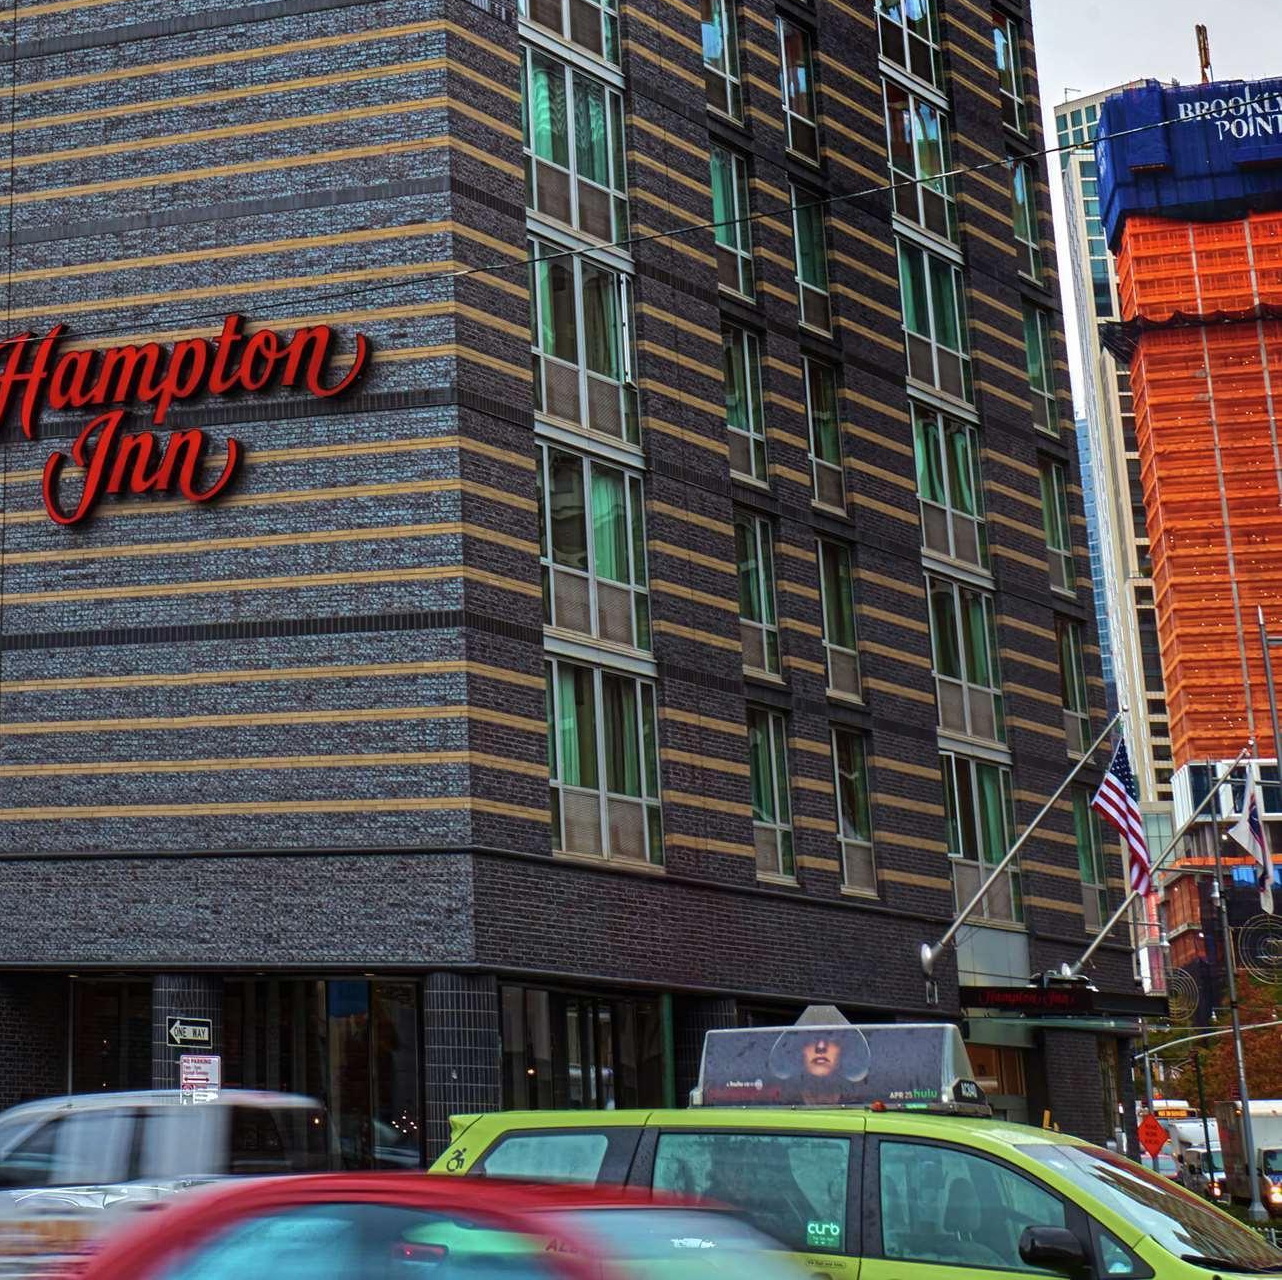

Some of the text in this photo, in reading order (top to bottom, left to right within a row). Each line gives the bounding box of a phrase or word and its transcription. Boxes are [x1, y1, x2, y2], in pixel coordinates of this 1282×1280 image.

[43, 410, 239, 527] Inn
[174, 1026, 206, 1039] ONE WAY
[889, 1091, 904, 1099] APR
[913, 1088, 938, 1098] hulu
[807, 1222, 840, 1236] curb
